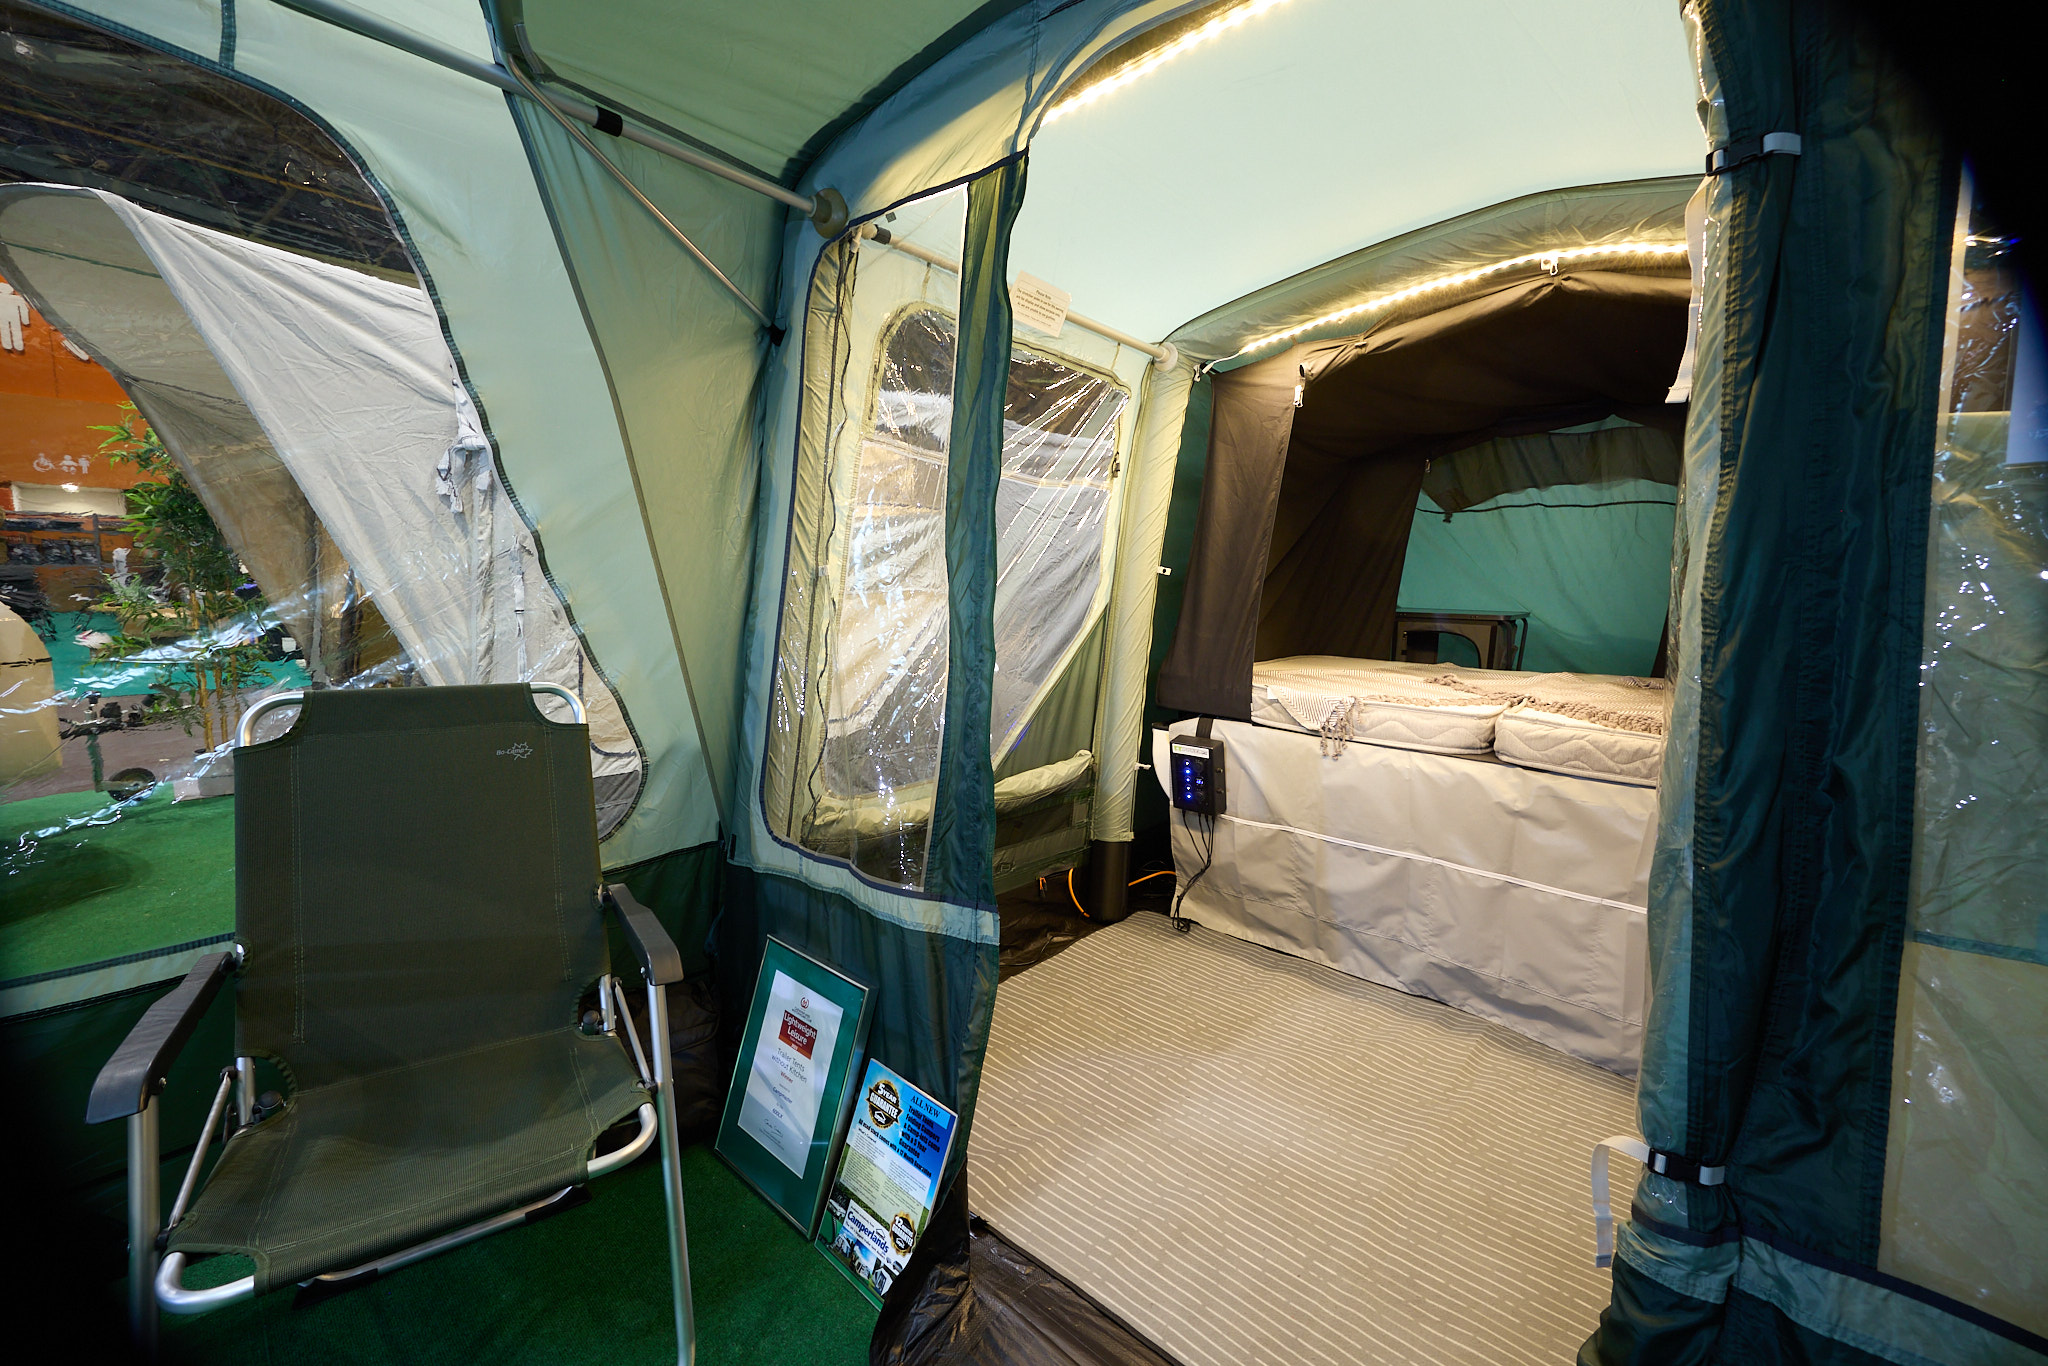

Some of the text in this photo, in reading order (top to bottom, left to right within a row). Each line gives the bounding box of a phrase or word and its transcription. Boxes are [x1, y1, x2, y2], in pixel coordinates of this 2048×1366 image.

[783, 1012, 817, 1042] Lightweight
[787, 1026, 808, 1045] Leisure
[771, 1054, 808, 1084] without Kitchen
[777, 1047, 792, 1063] Trailer
[791, 1057, 806, 1073] Tents
[869, 1092, 899, 1119] GUARANTEE
[878, 1082, 898, 1105] 5 YEAR
[909, 1106, 922, 1120] Trailer
[911, 1094, 941, 1120] ALL NEW
[906, 1113, 922, 1130] Folding
[921, 1125, 940, 1143] Campers
[863, 1122, 871, 1131] used
[870, 1127, 879, 1138] stock
[879, 1134, 890, 1146] comes
[889, 1142, 897, 1151] with
[903, 1152, 915, 1165] Month
[914, 1160, 932, 1178] Guarantee
[899, 1138, 921, 1159] Guarantee
[901, 1131, 911, 1141] with
[917, 1142, 927, 1153] Year
[928, 1140, 940, 1153] come
[847, 1210, 890, 1254] Camperlands
[894, 1215, 904, 1229] 12
[891, 1224, 914, 1248] GUARANTEE
